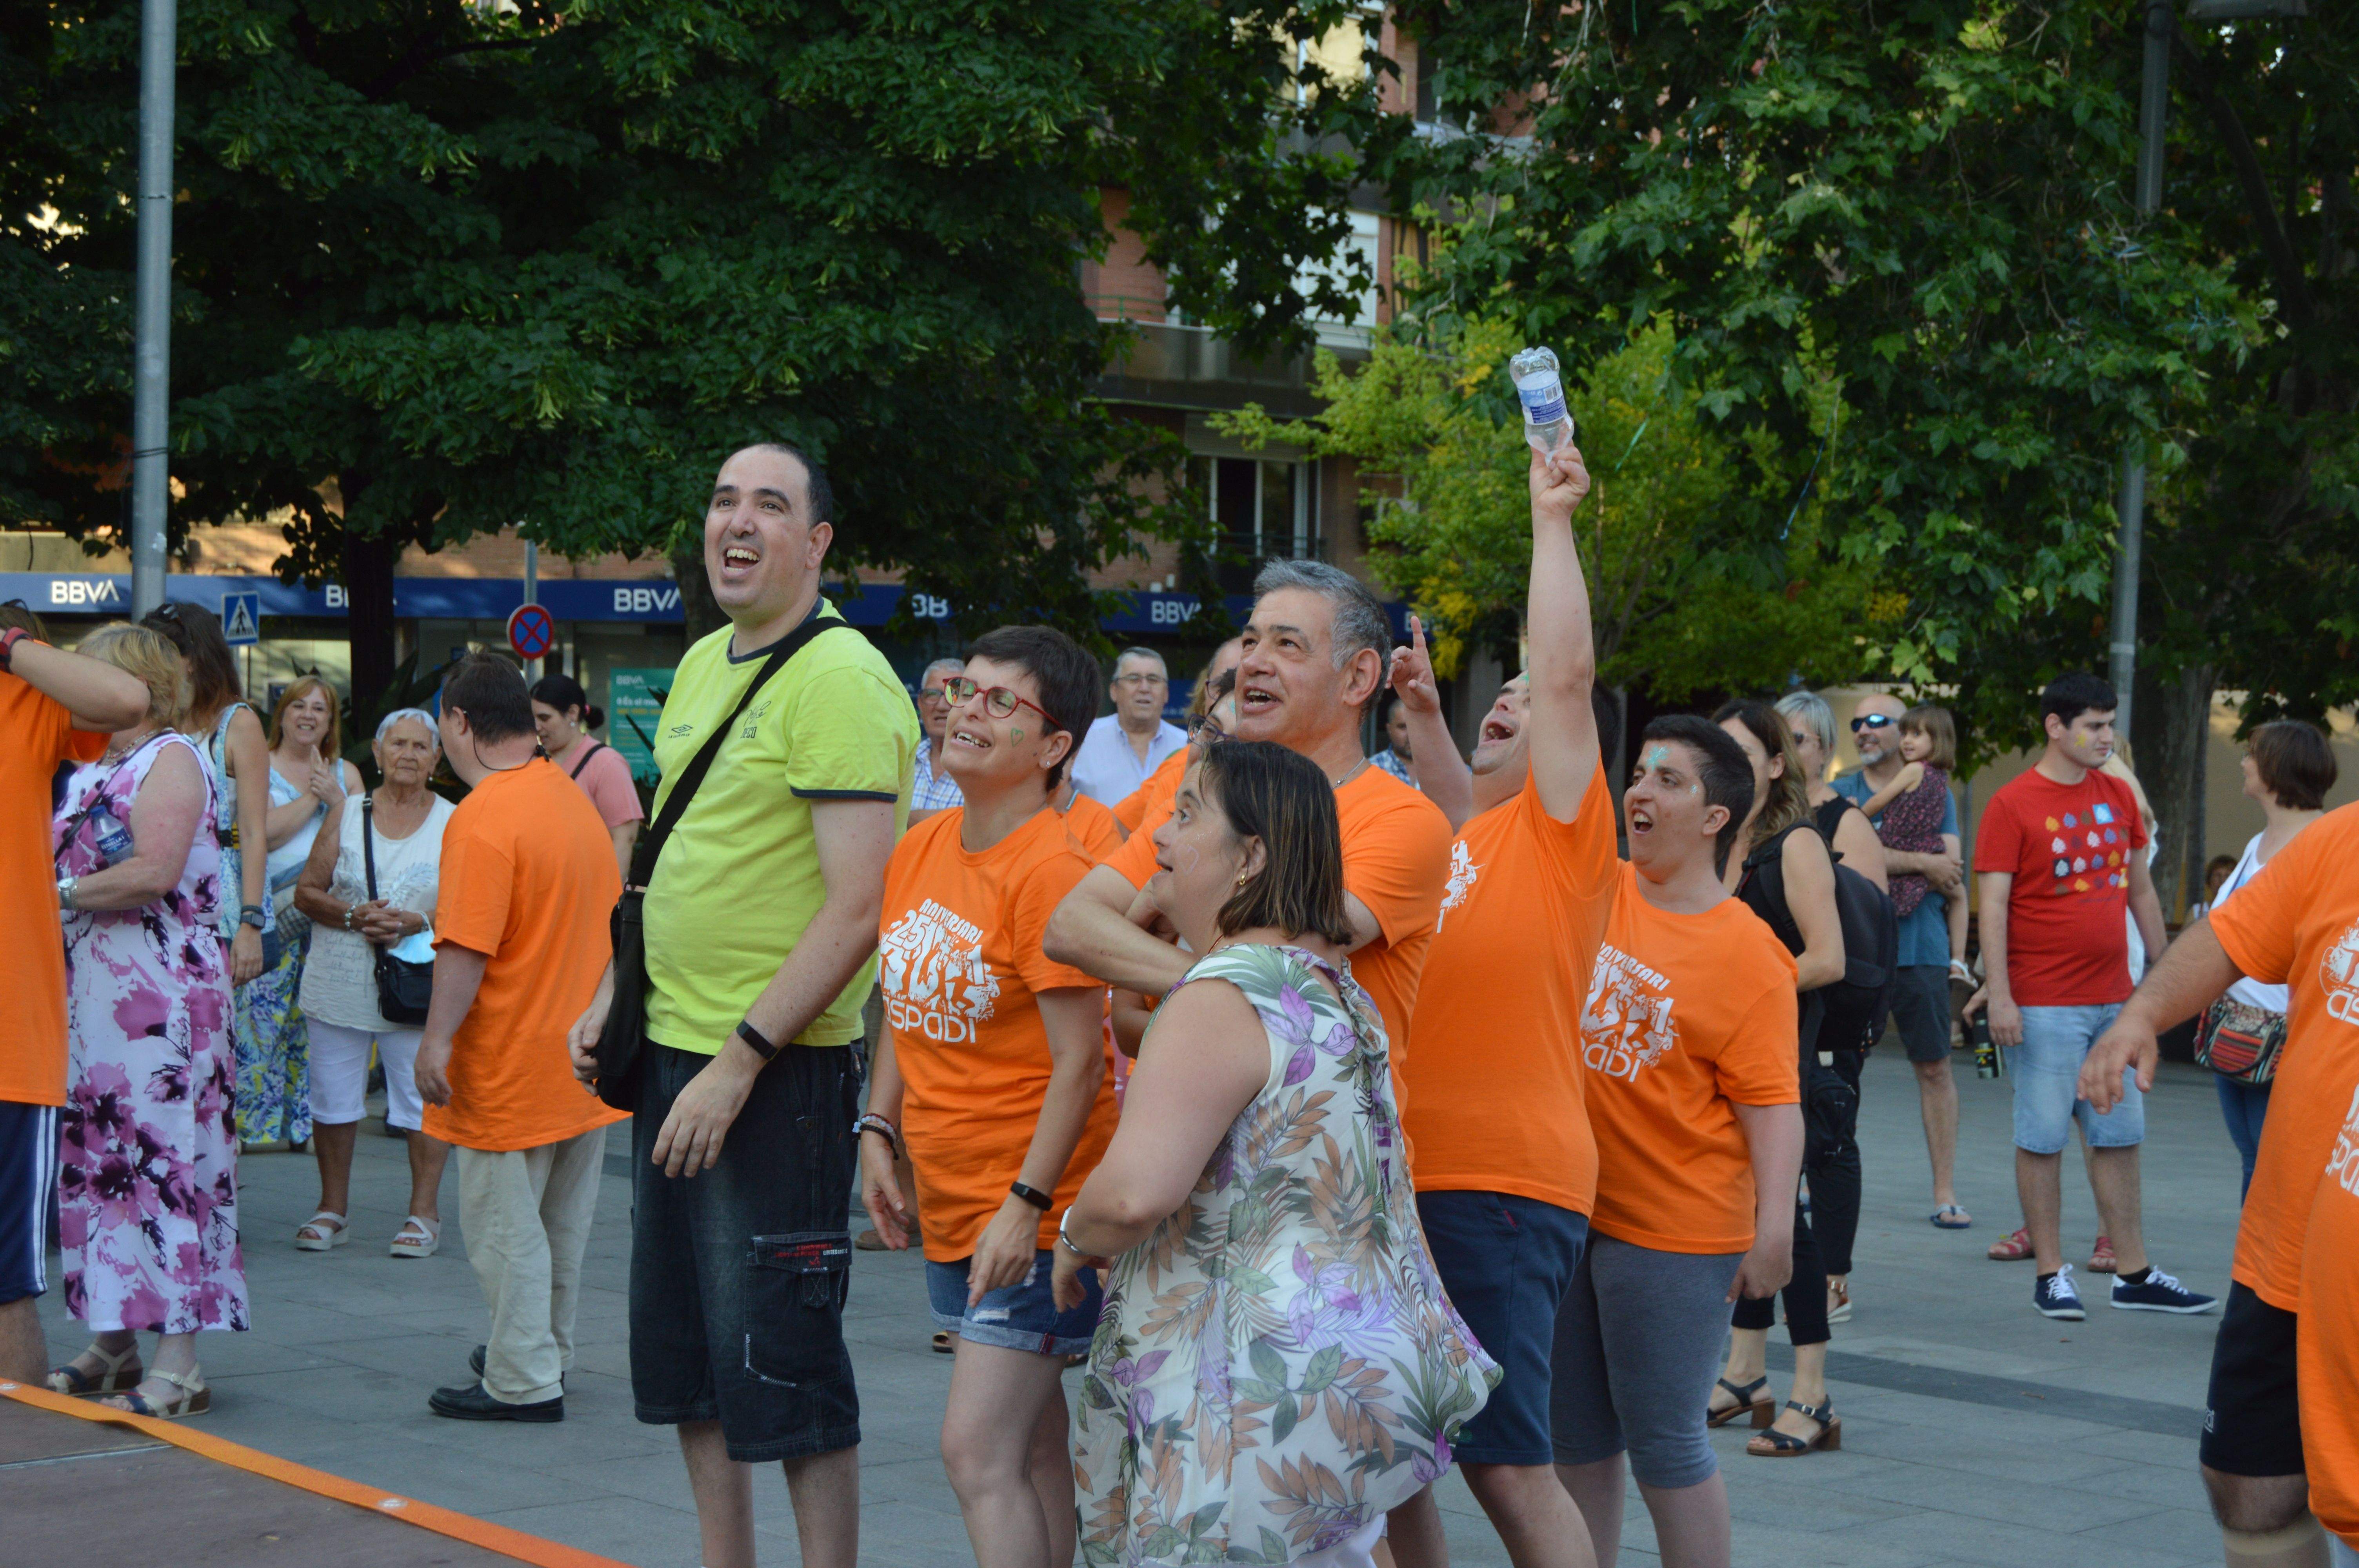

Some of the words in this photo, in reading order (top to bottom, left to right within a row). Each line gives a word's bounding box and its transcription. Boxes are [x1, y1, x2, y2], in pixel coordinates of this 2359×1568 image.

[51, 579, 120, 604] BBVA
[614, 587, 681, 612] BBVA
[887, 909, 932, 951] 25
[919, 898, 983, 944] ANIVERSARI
[1600, 941, 1670, 991] NIVERSARI
